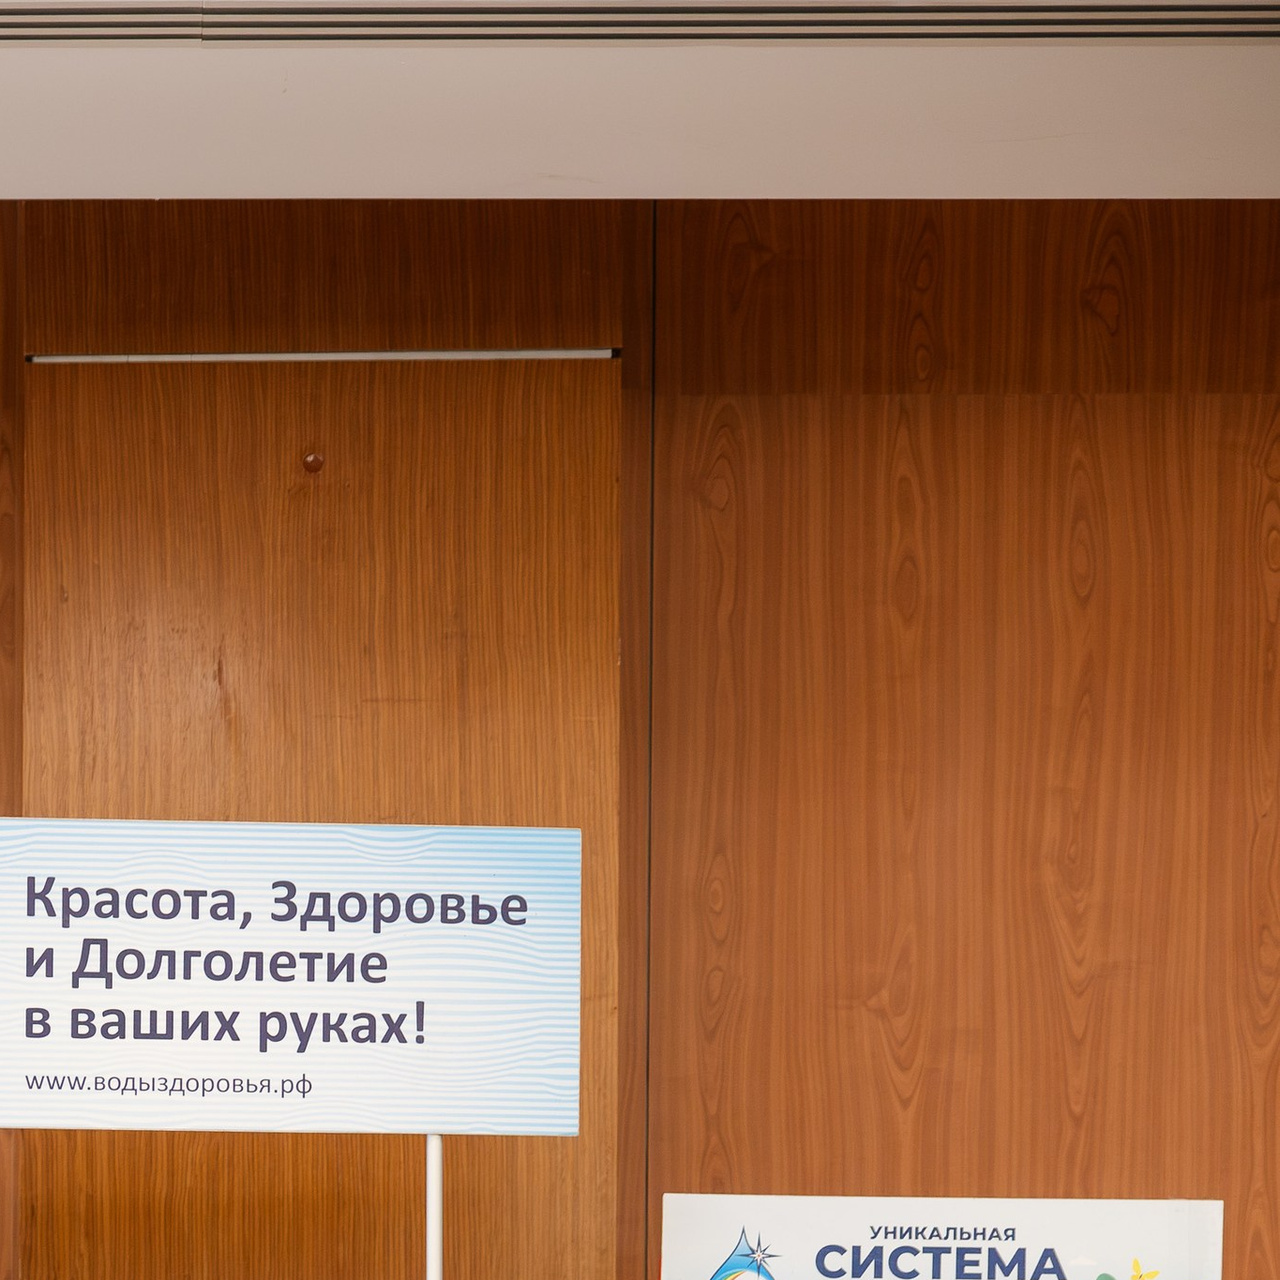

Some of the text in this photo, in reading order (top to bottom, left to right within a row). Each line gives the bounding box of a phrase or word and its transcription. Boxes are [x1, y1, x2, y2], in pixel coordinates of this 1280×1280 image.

[25, 876, 528, 933] Красота, Здоровье
[26, 937, 387, 985] и Долголетие
[25, 1001, 426, 1052] в ваших руках!
[25, 1071, 312, 1097] www.водыздоровья.рф
[869, 1226, 1016, 1242] УНИКАЛЬНАЯ
[815, 1244, 1067, 1280] СИСТЕМА
